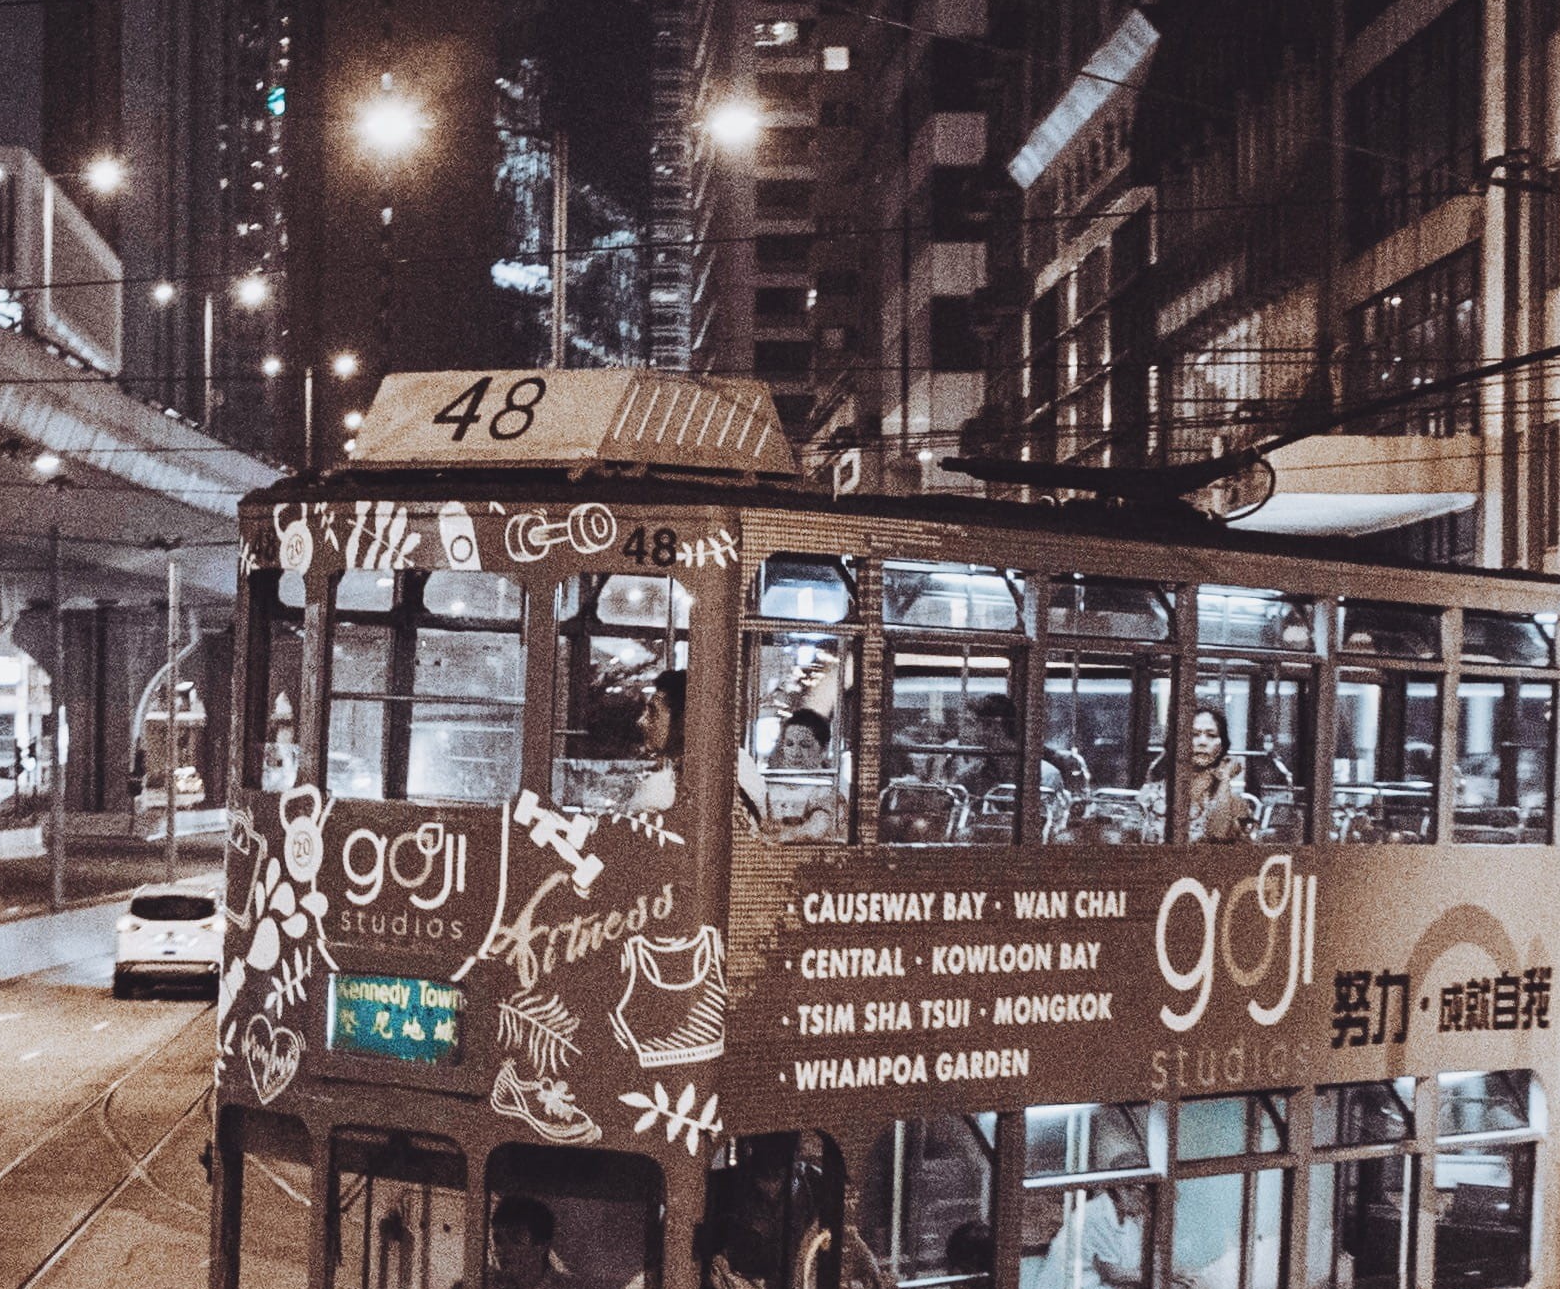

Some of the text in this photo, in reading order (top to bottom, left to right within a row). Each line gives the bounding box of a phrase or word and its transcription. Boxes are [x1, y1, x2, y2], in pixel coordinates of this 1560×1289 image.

[432, 375, 547, 442] 48
[623, 524, 677, 568] 48
[342, 822, 467, 911] goji
[339, 909, 465, 941] studios
[802, 890, 1127, 924] CAUSEWAY BAY WAN CHAI
[800, 941, 1101, 980] CENTRAL KOWLOON BAY
[1155, 854, 1318, 1032] goji
[417, 979, 464, 1010] Town
[797, 992, 1114, 1036] TSIM SHA TSUI MONGKOK
[794, 1048, 1030, 1092] WHAMPOA GARDEN
[1149, 1034, 1310, 1091] studios
